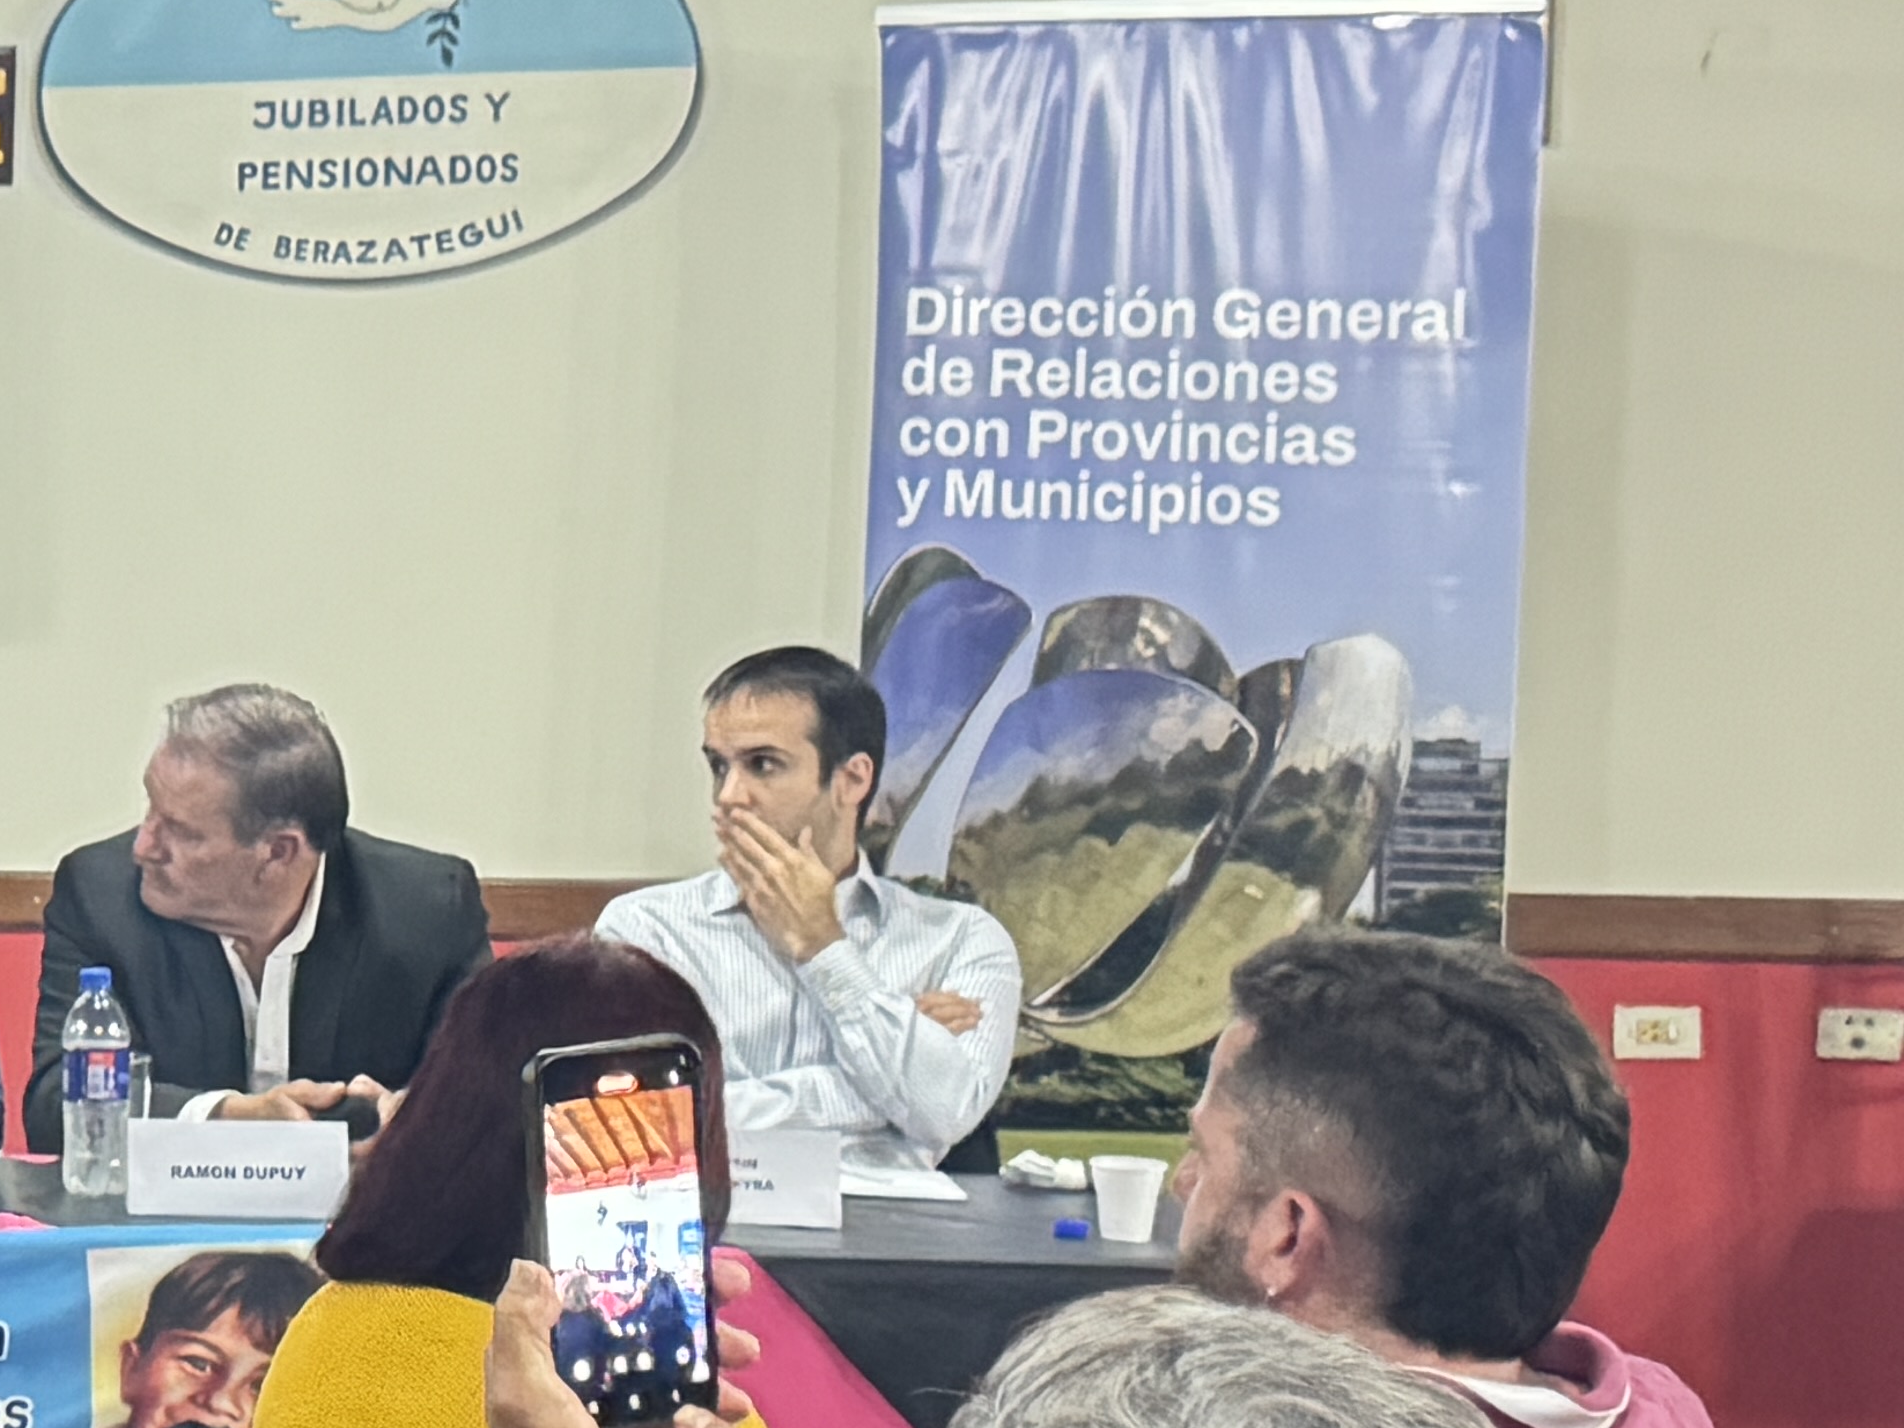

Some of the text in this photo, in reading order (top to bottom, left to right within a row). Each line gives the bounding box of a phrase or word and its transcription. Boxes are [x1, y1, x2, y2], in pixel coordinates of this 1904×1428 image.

[253, 92, 511, 130] JUBILADOS Y
[237, 153, 520, 192] PENSIONADOS
[214, 208, 524, 265] DE BERAZATEGUI
[905, 285, 1467, 341] Dirección General
[901, 345, 1339, 403] de Relaciones
[898, 409, 1357, 465] con Provincias
[896, 469, 1282, 535] y Municipios
[171, 1164, 306, 1180] RAMON DUPUY
